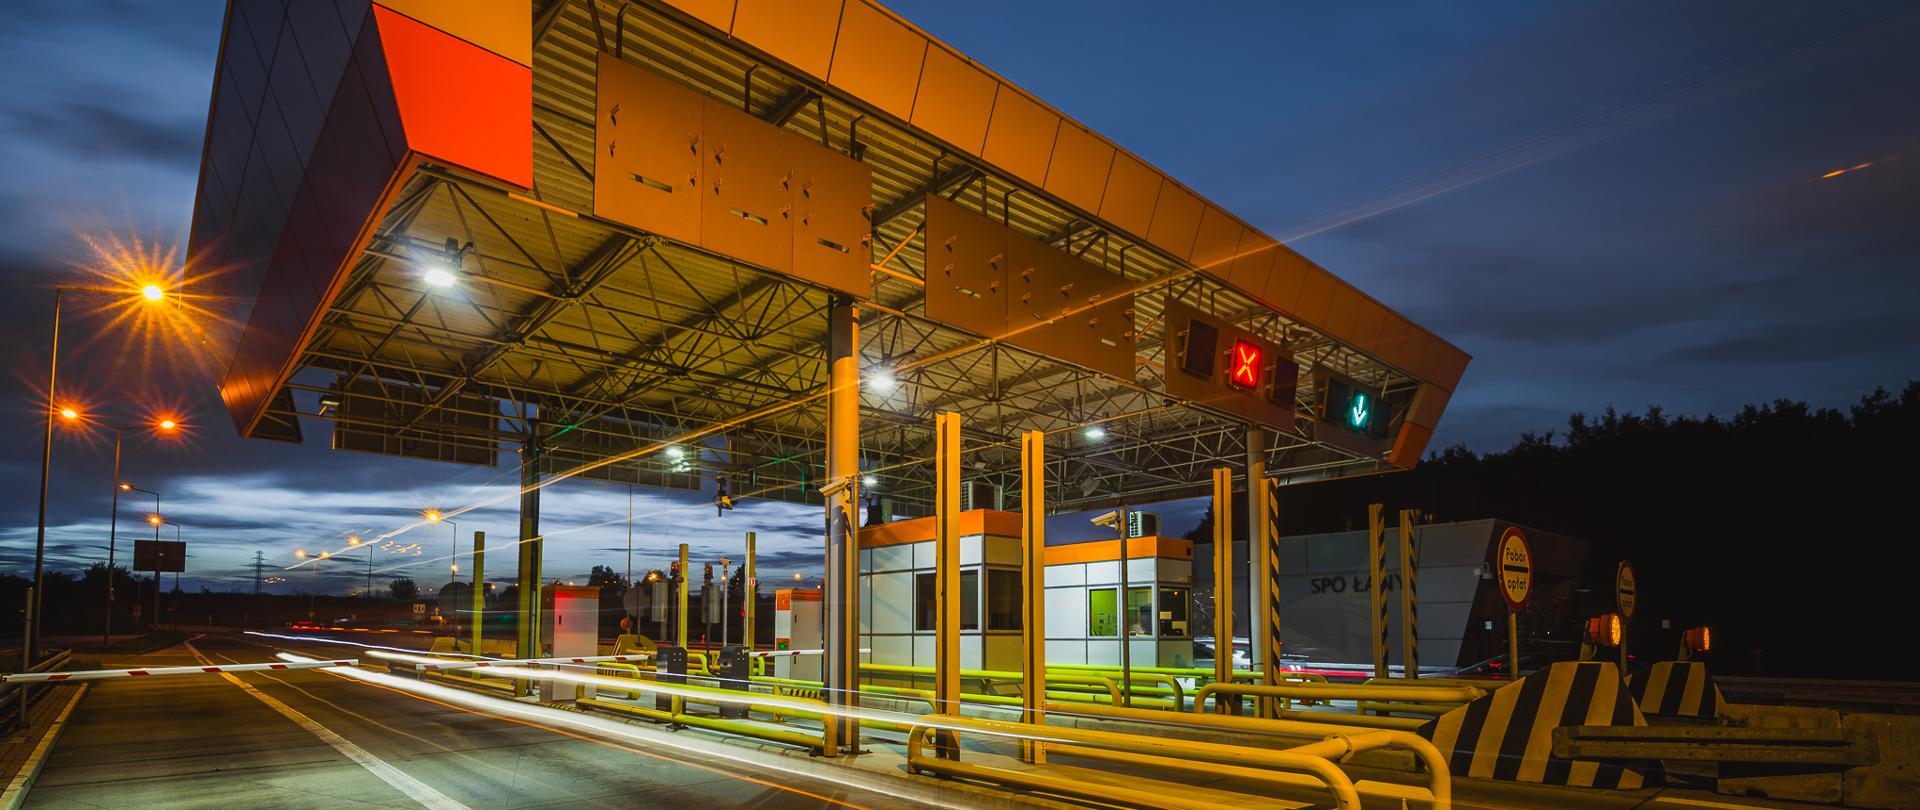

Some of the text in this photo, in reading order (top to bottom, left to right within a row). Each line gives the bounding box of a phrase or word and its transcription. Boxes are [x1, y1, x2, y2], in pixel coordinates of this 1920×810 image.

[1506, 547, 1526, 562] Pobór
[1310, 576, 1346, 594] SPO
[1507, 576, 1526, 593] opłat
